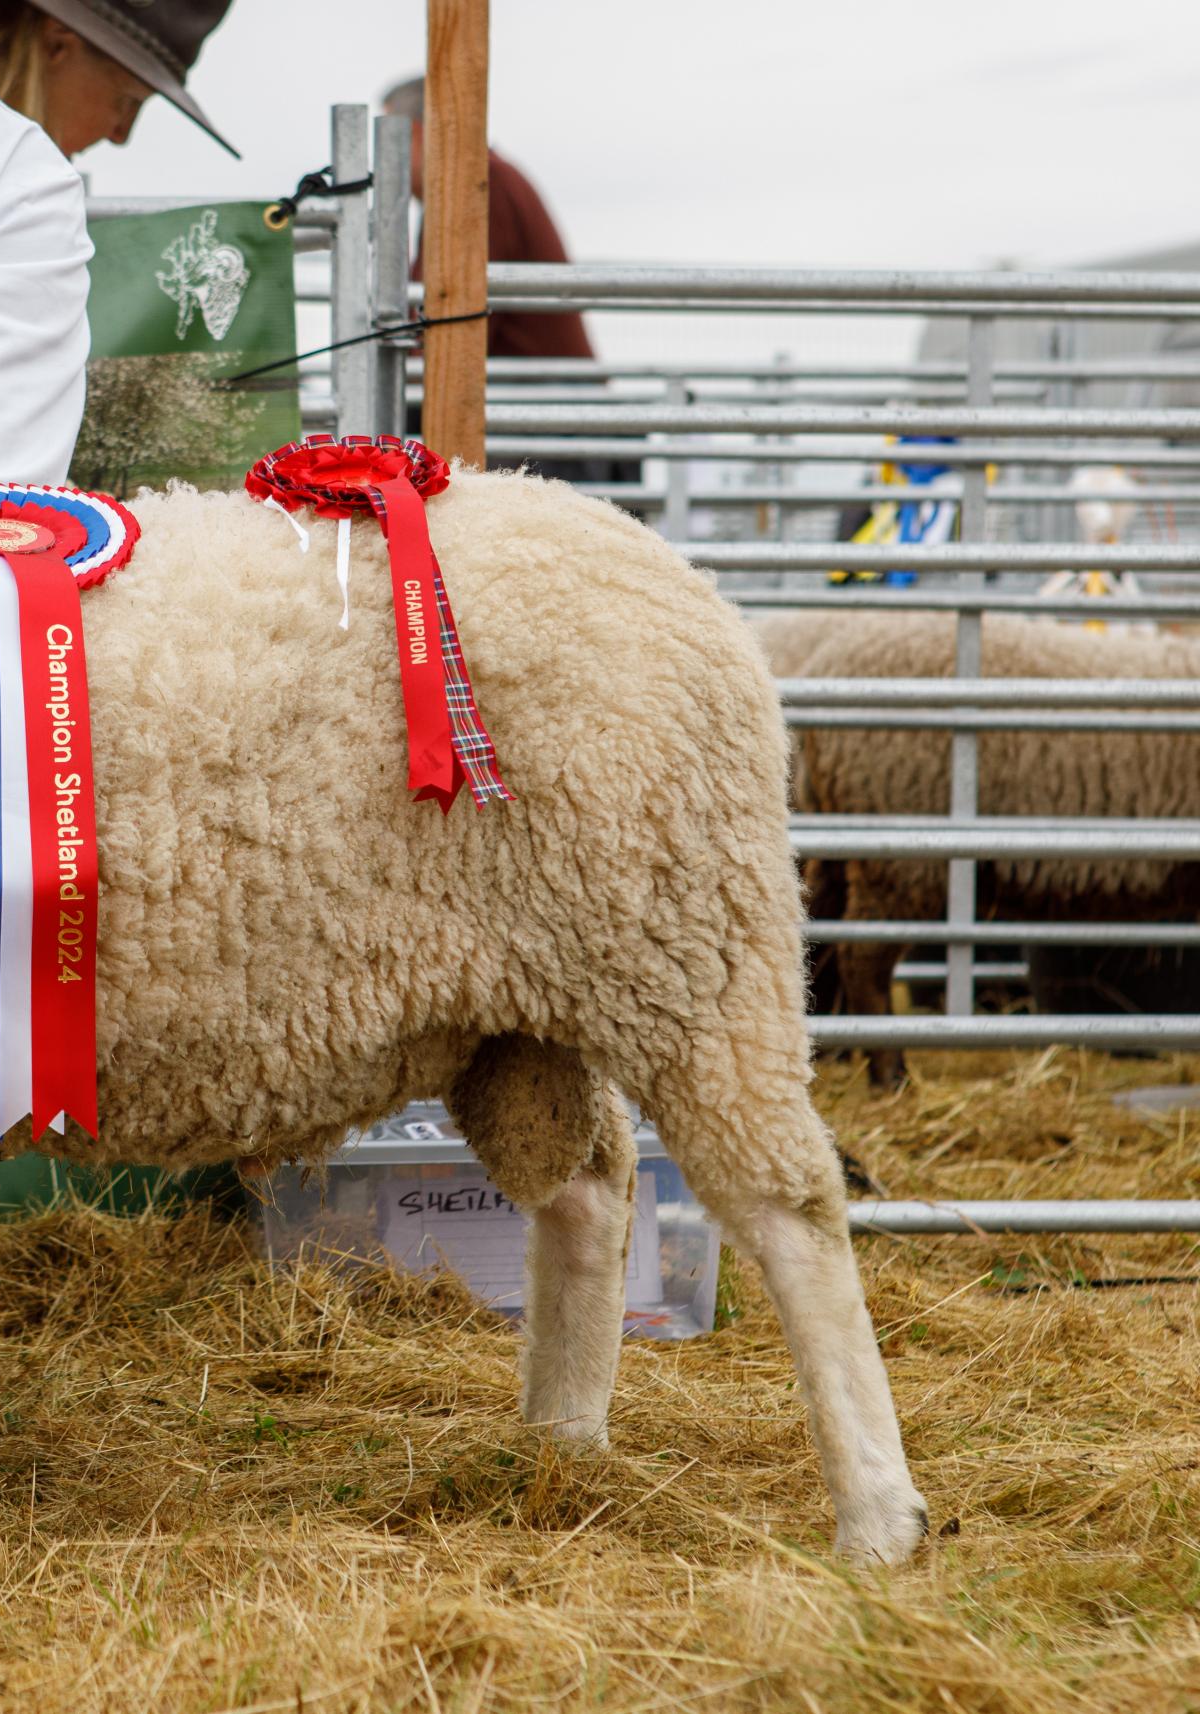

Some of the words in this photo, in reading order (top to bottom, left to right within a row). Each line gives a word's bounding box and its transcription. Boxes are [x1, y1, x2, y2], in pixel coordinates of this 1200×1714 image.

[403, 579, 427, 665] CHAMPION
[46, 623, 77, 763] Champion
[54, 773, 85, 901] Shetland
[58, 910, 84, 984] 2024
